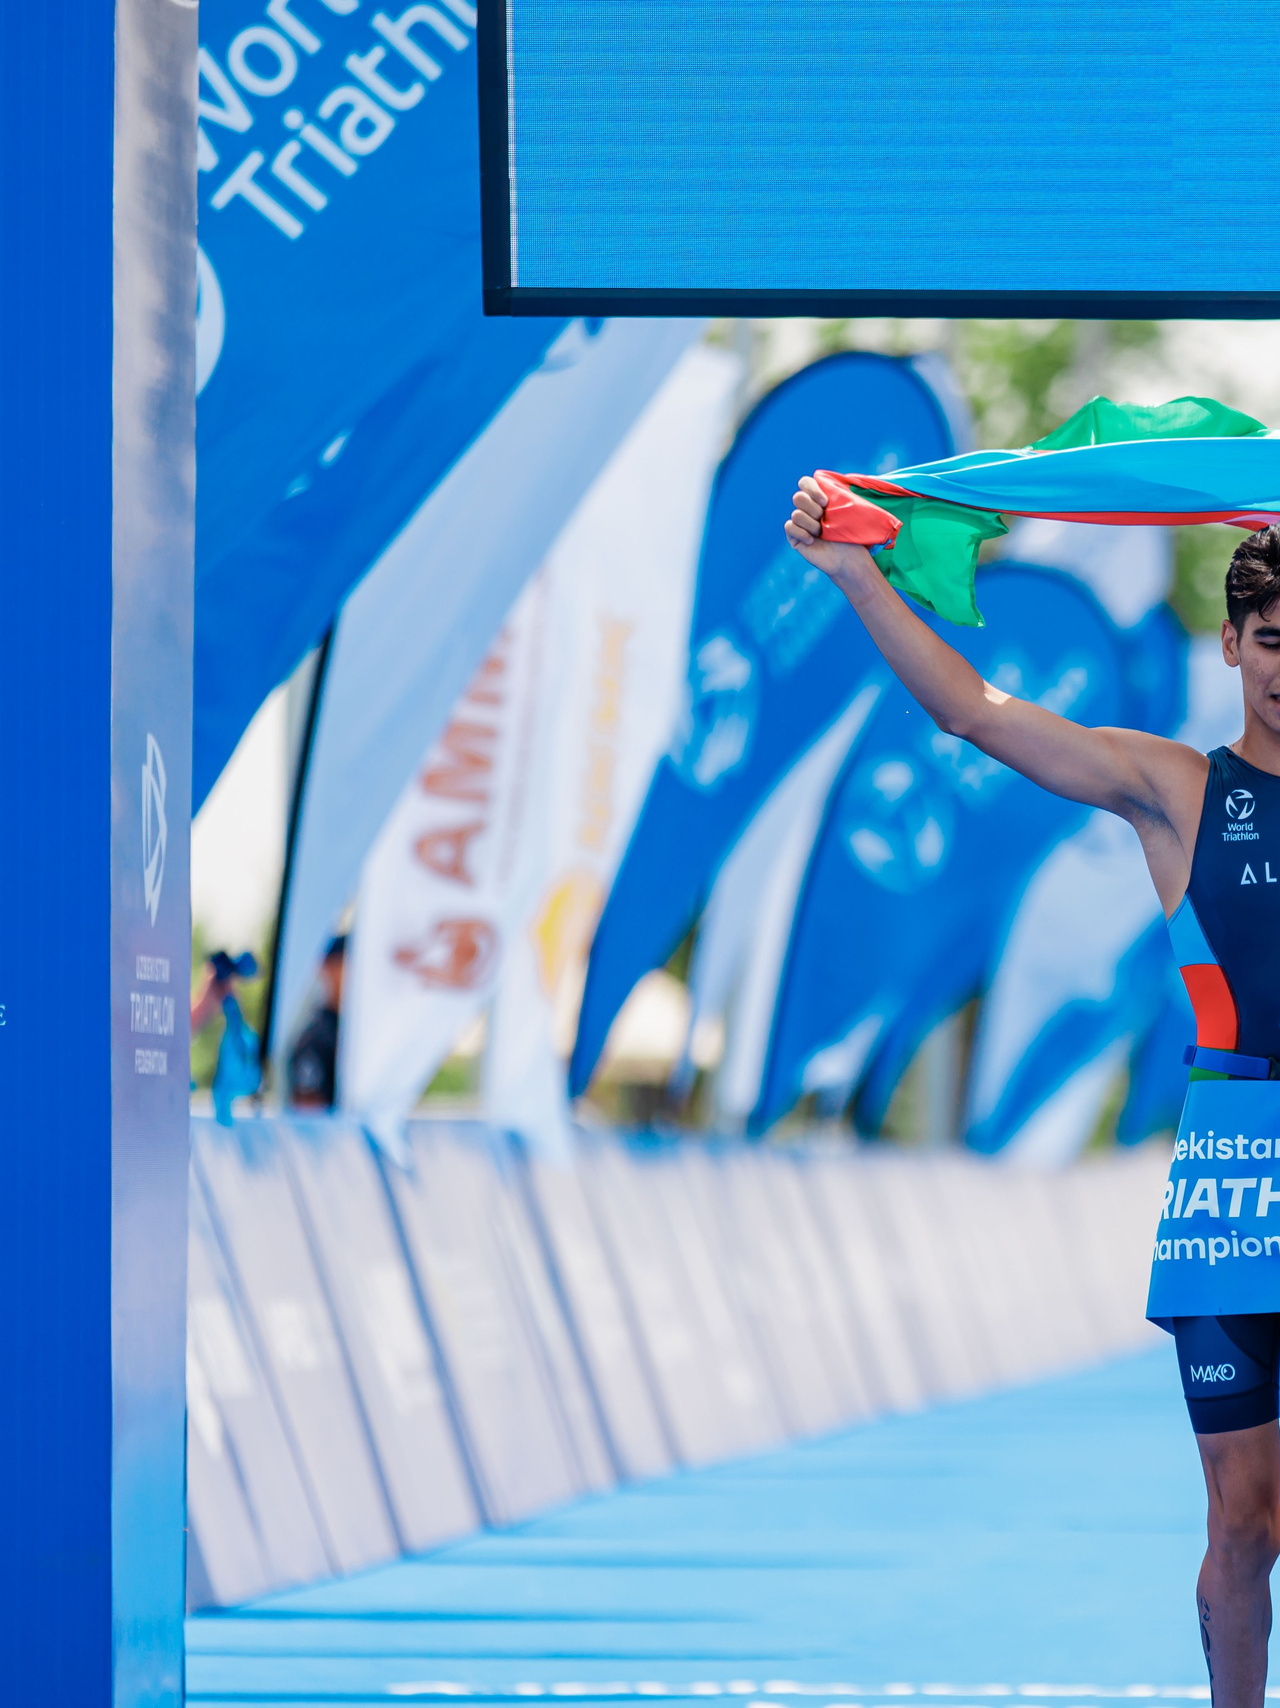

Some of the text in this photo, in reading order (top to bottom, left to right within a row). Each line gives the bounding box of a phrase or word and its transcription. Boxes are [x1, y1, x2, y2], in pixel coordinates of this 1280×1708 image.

[209, 0, 477, 240] Triath
[1221, 831, 1260, 842] Triathlon
[1227, 822, 1254, 832] World
[130, 991, 176, 1037] TRIATHLON
